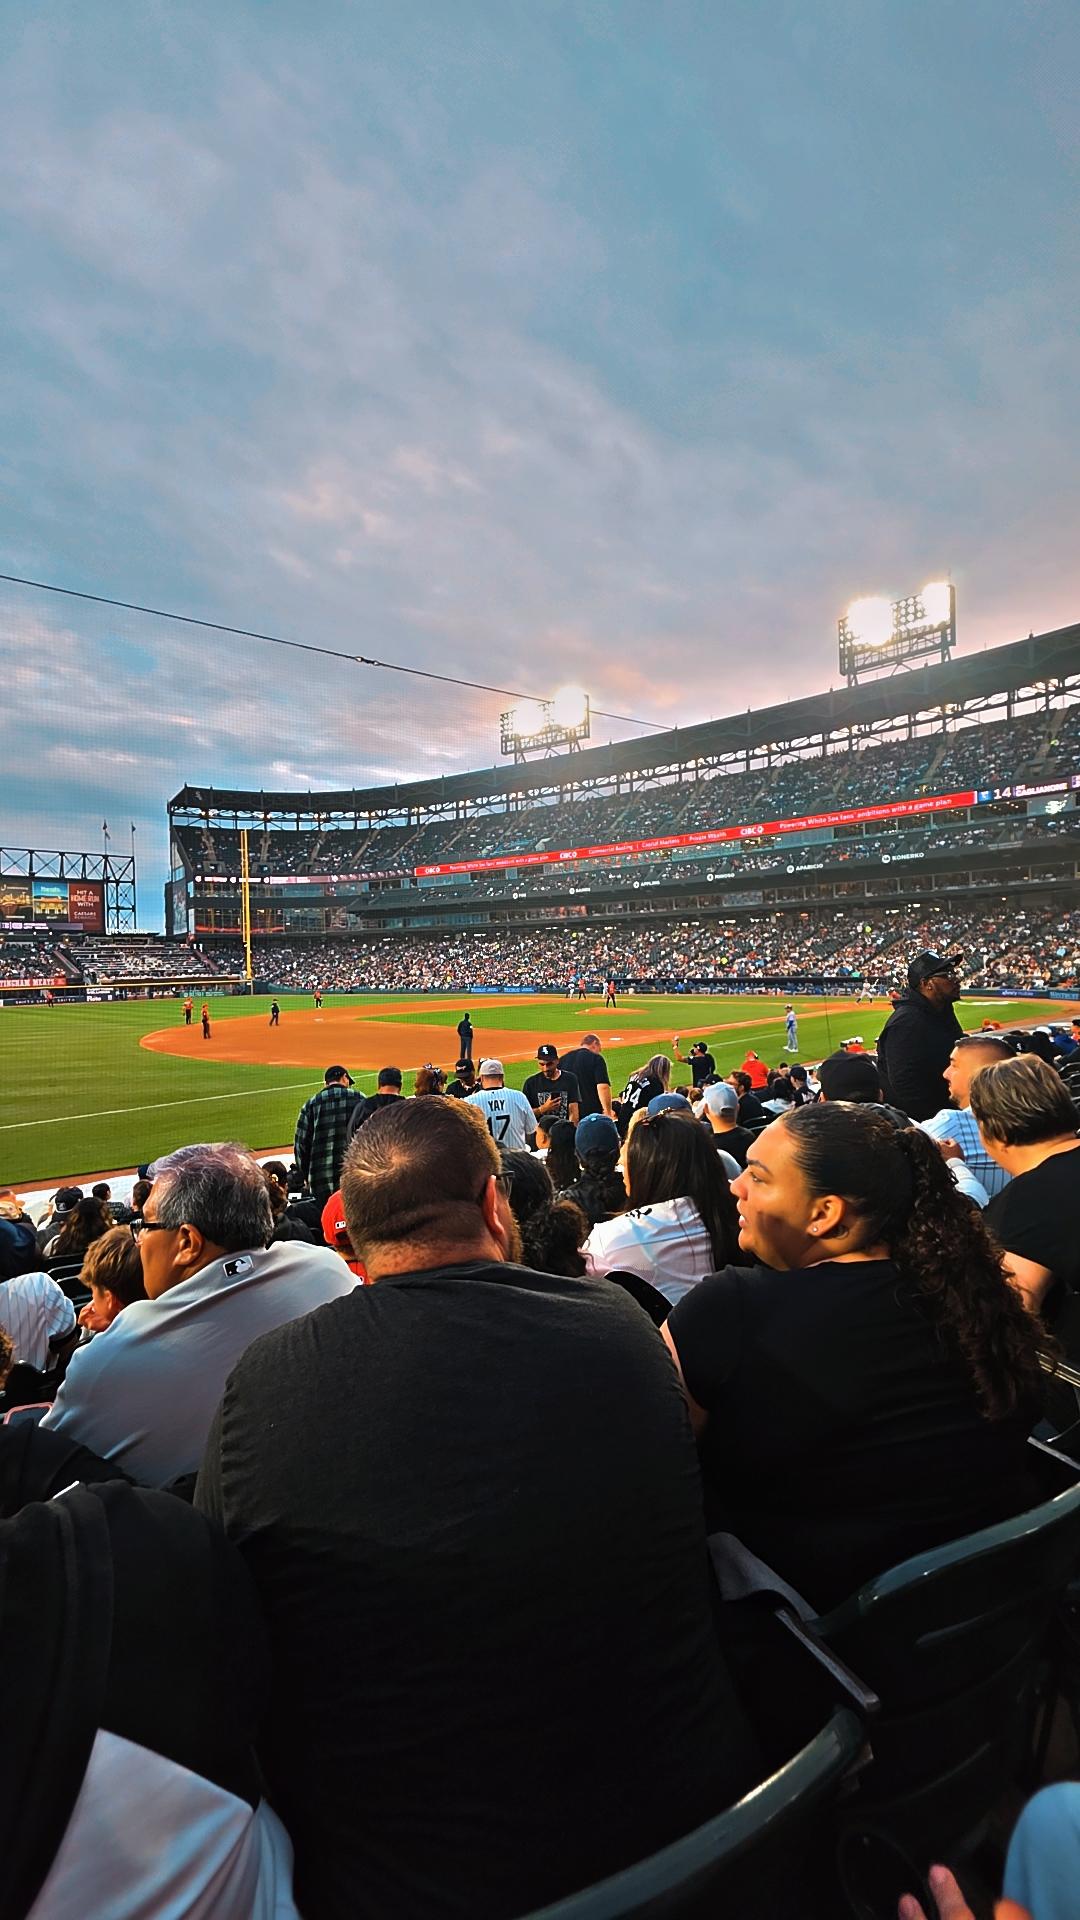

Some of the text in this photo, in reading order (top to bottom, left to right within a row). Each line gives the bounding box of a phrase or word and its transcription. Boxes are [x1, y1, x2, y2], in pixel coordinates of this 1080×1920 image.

[994, 787, 1011, 799] 14
[807, 816, 827, 824] White
[891, 804, 906, 813] with
[914, 801, 933, 811] game
[935, 798, 952, 807] plan
[740, 827, 757, 836] CIBC
[892, 852, 924, 861] KONERKO
[32, 978, 55, 986] MEATS
[622, 1083, 641, 1109] 34
[488, 1099, 505, 1111] YAY
[487, 1114, 510, 1140] 17
